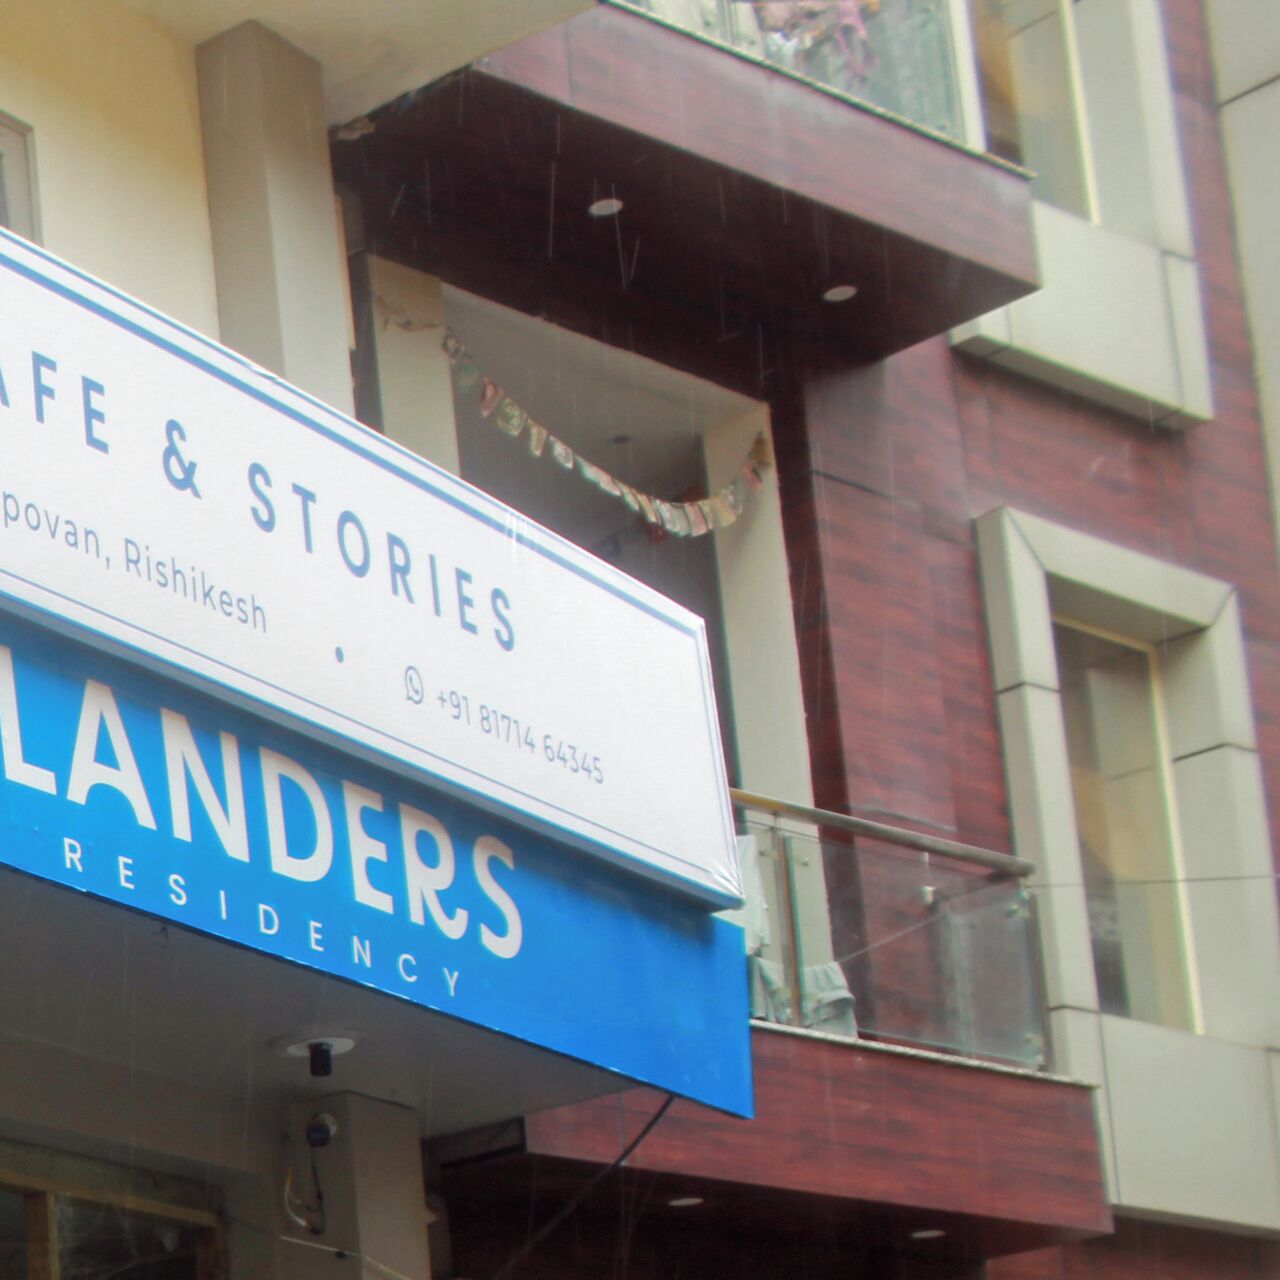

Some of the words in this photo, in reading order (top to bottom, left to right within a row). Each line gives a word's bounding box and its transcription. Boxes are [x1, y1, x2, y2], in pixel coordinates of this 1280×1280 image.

[122, 536, 269, 635] Rishikesh
[161, 418, 203, 500] &
[247, 461, 517, 653] STORIES
[436, 688, 472, 727] +91
[479, 700, 537, 753] 81714
[543, 730, 606, 786] 64345
[63, 835, 461, 998] RESIDENCY
